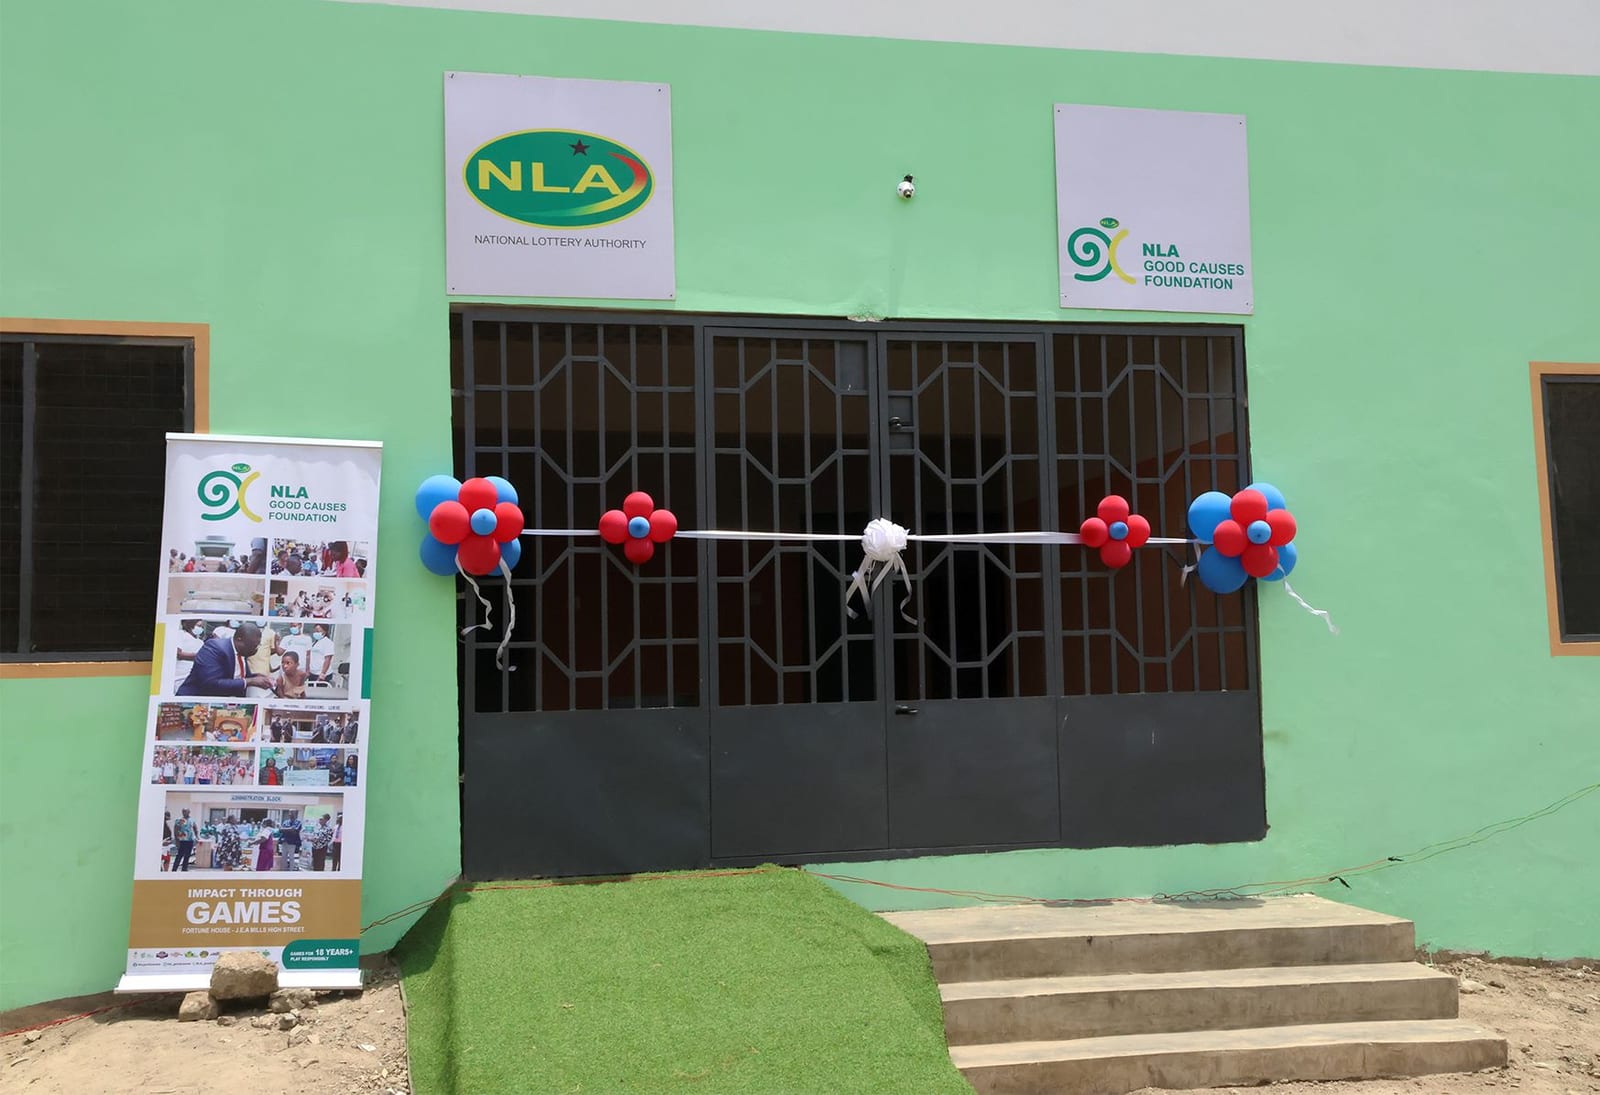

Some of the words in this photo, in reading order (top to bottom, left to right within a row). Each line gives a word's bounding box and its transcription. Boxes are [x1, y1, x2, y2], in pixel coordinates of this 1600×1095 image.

[478, 159, 623, 195] NLA
[474, 235, 529, 246] NATIONAL
[532, 237, 582, 247] LOTTERY
[584, 238, 646, 249] AUTHORITY
[1142, 243, 1180, 257] NLA
[1144, 260, 1185, 272] GOOD
[1189, 263, 1244, 276] CAUSES
[1145, 276, 1233, 290] FOUNDATION
[271, 485, 309, 499] NLA
[270, 500, 301, 510] GOOD
[304, 502, 347, 511] CAUSES
[269, 512, 337, 523] FOUNDATION
[188, 889, 236, 898] IMPACT
[240, 888, 302, 897] THROUGH
[186, 901, 301, 924] GAMES
